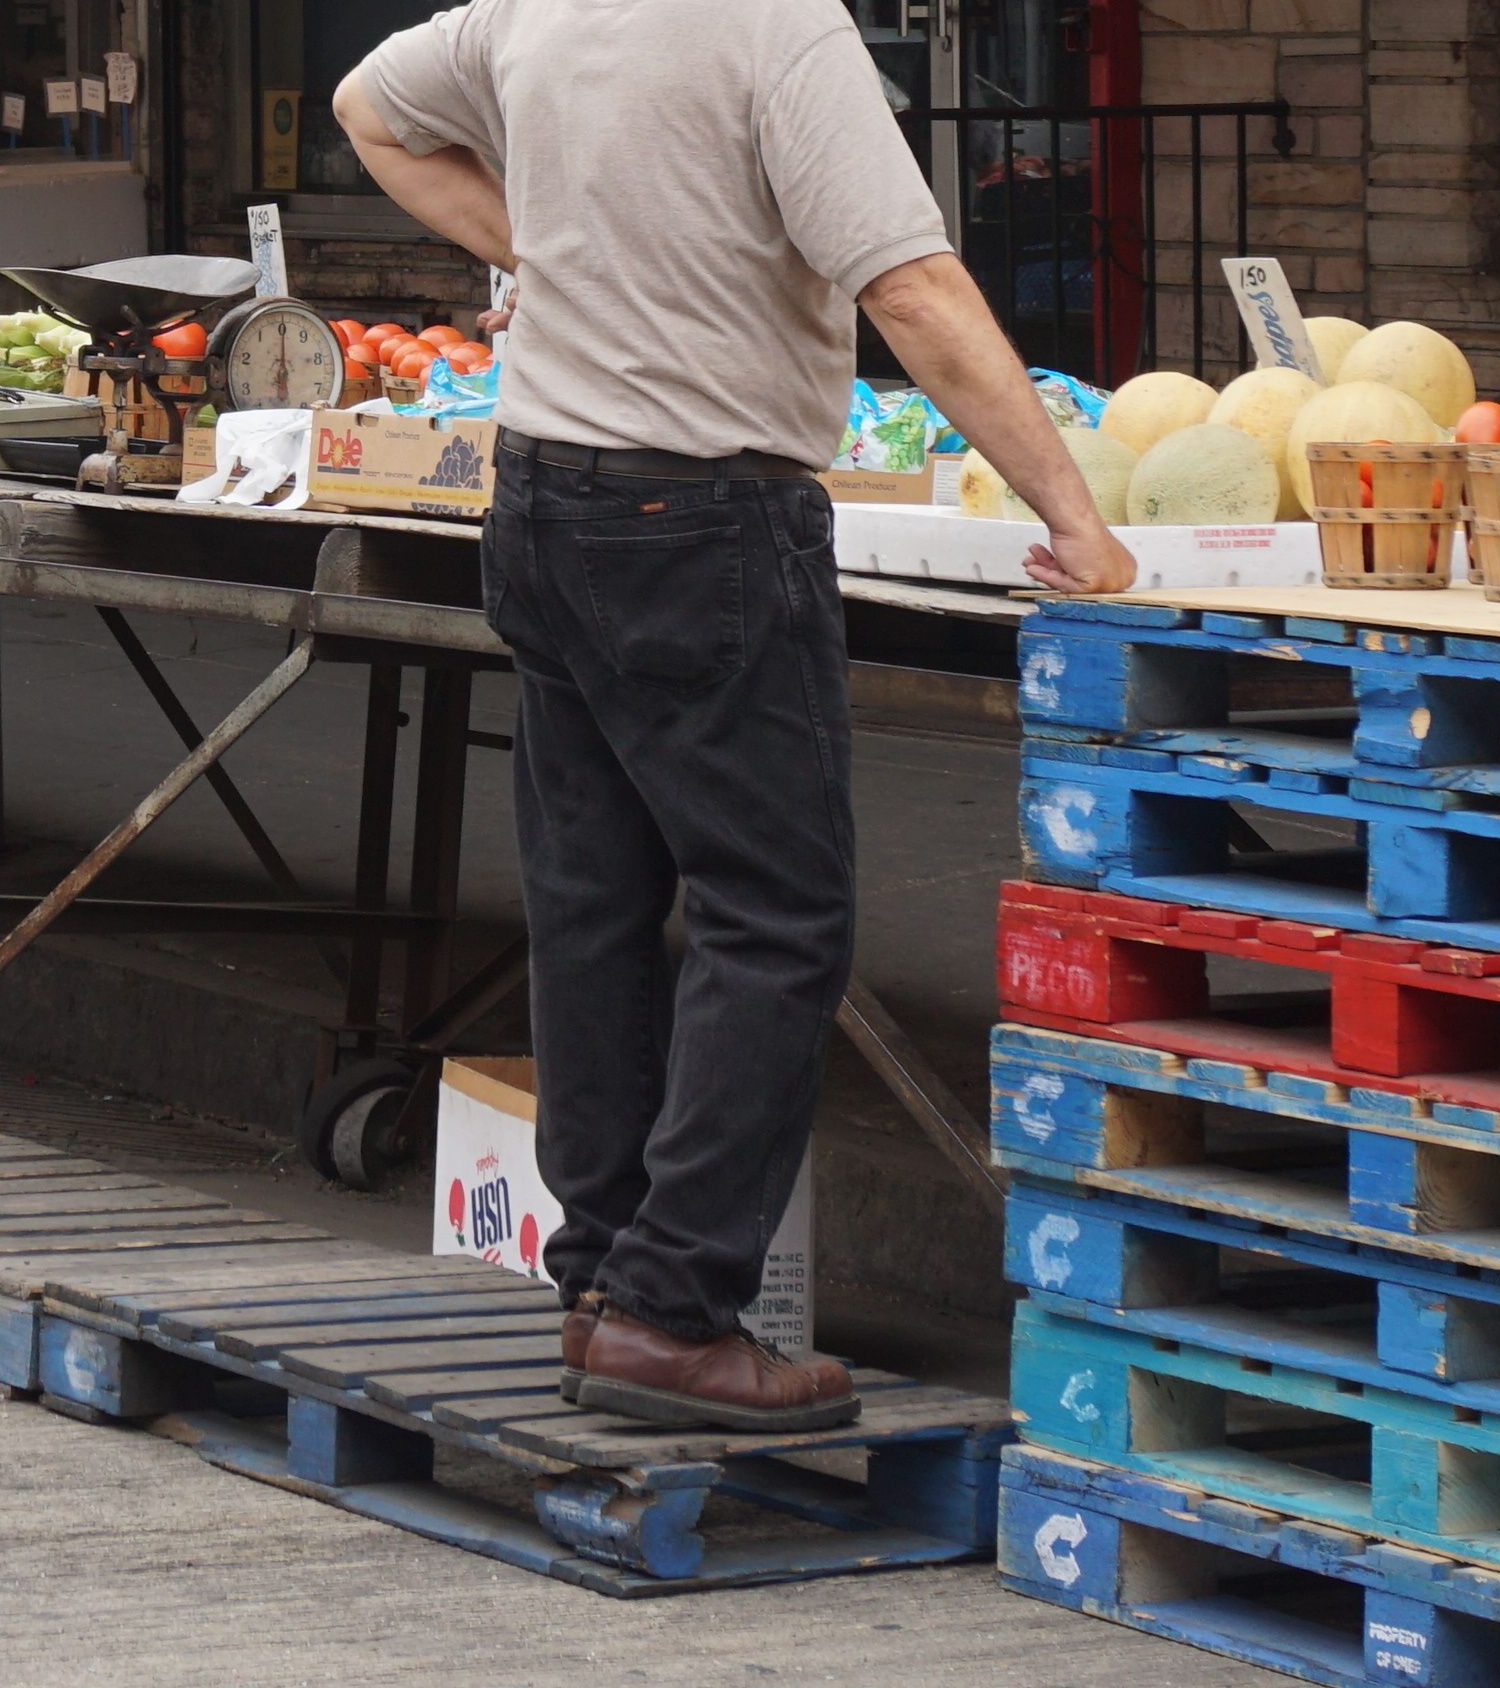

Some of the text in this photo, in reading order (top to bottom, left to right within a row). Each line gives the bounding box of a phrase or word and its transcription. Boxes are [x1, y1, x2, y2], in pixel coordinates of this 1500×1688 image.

[317, 427, 363, 467] Dole
[832, 478, 897, 493] Chilean Produce
[471, 1176, 512, 1250] USA
[1369, 1621, 1427, 1650] PROPERTY
